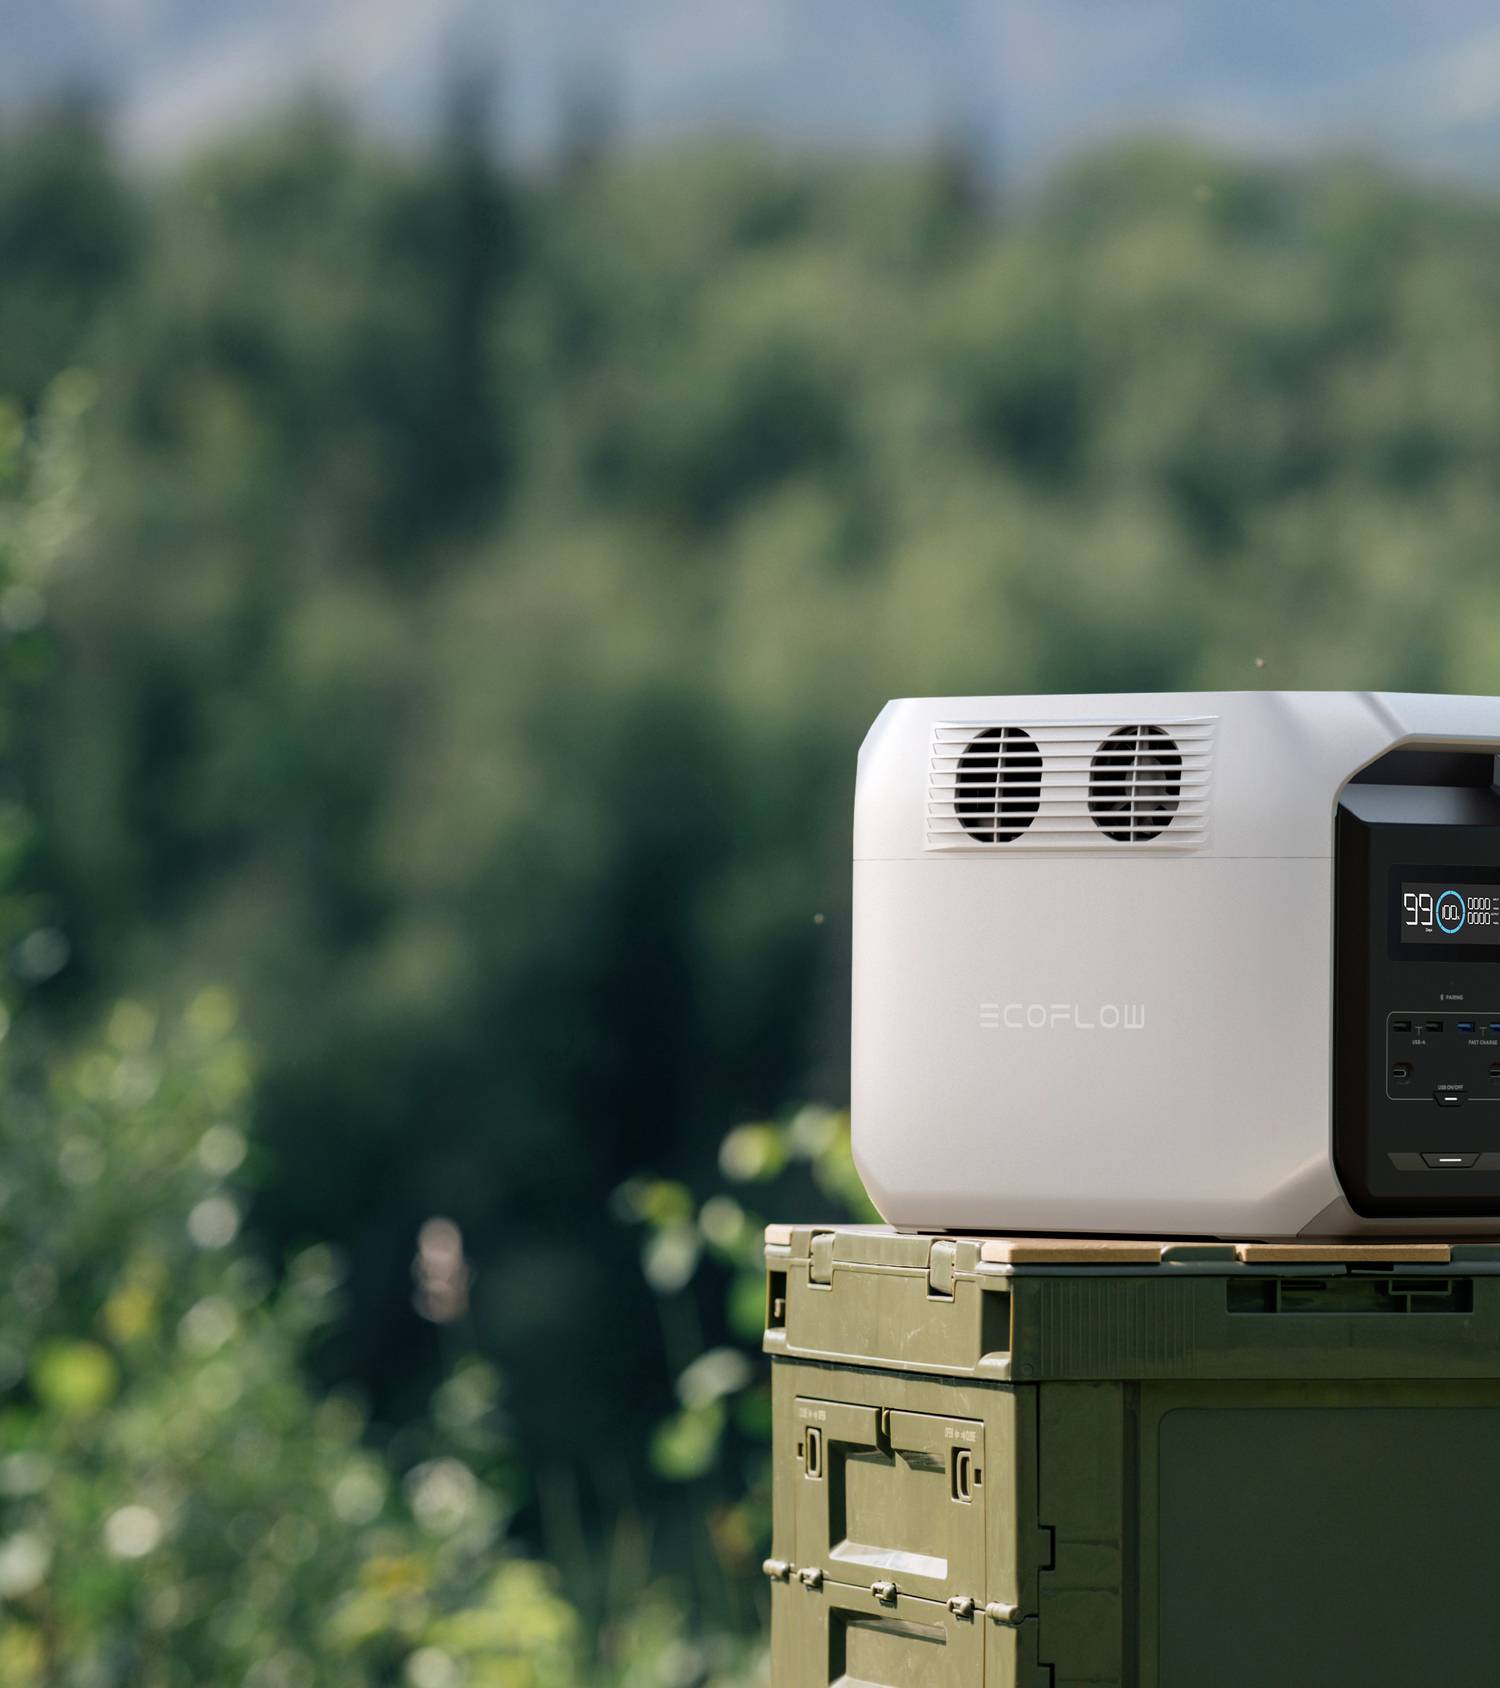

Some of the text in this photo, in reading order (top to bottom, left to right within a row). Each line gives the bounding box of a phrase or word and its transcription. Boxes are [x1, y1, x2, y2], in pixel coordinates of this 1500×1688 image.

[1404, 893, 1433, 925] 99
[1467, 897, 1490, 910] 0000
[1467, 911, 1490, 925] 0000
[979, 1003, 1145, 1029] ECOFLOW
